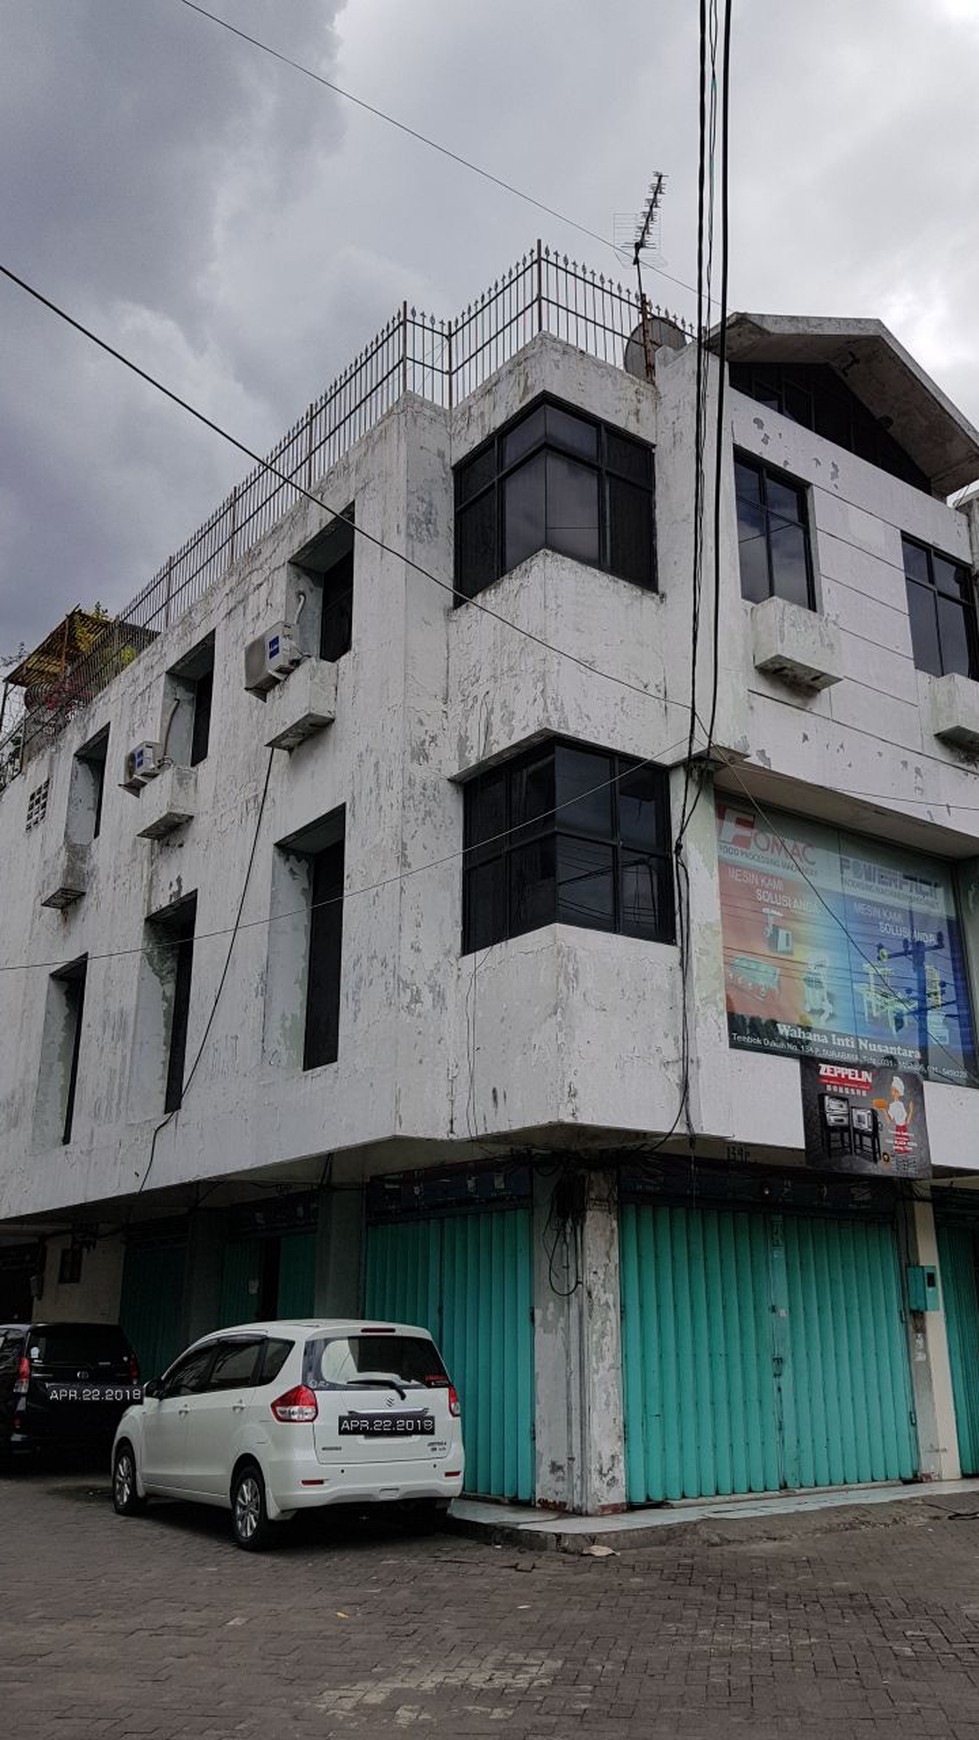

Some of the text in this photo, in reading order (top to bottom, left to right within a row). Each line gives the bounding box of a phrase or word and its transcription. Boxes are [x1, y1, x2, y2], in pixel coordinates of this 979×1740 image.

[717, 804, 816, 866] FOMAC
[755, 888, 792, 908] SOLUSI
[732, 1032, 762, 1045] Tembok
[776, 1023, 921, 1059] Wahana Inti Nusantara
[818, 1063, 873, 1083] ZEPPELIN
